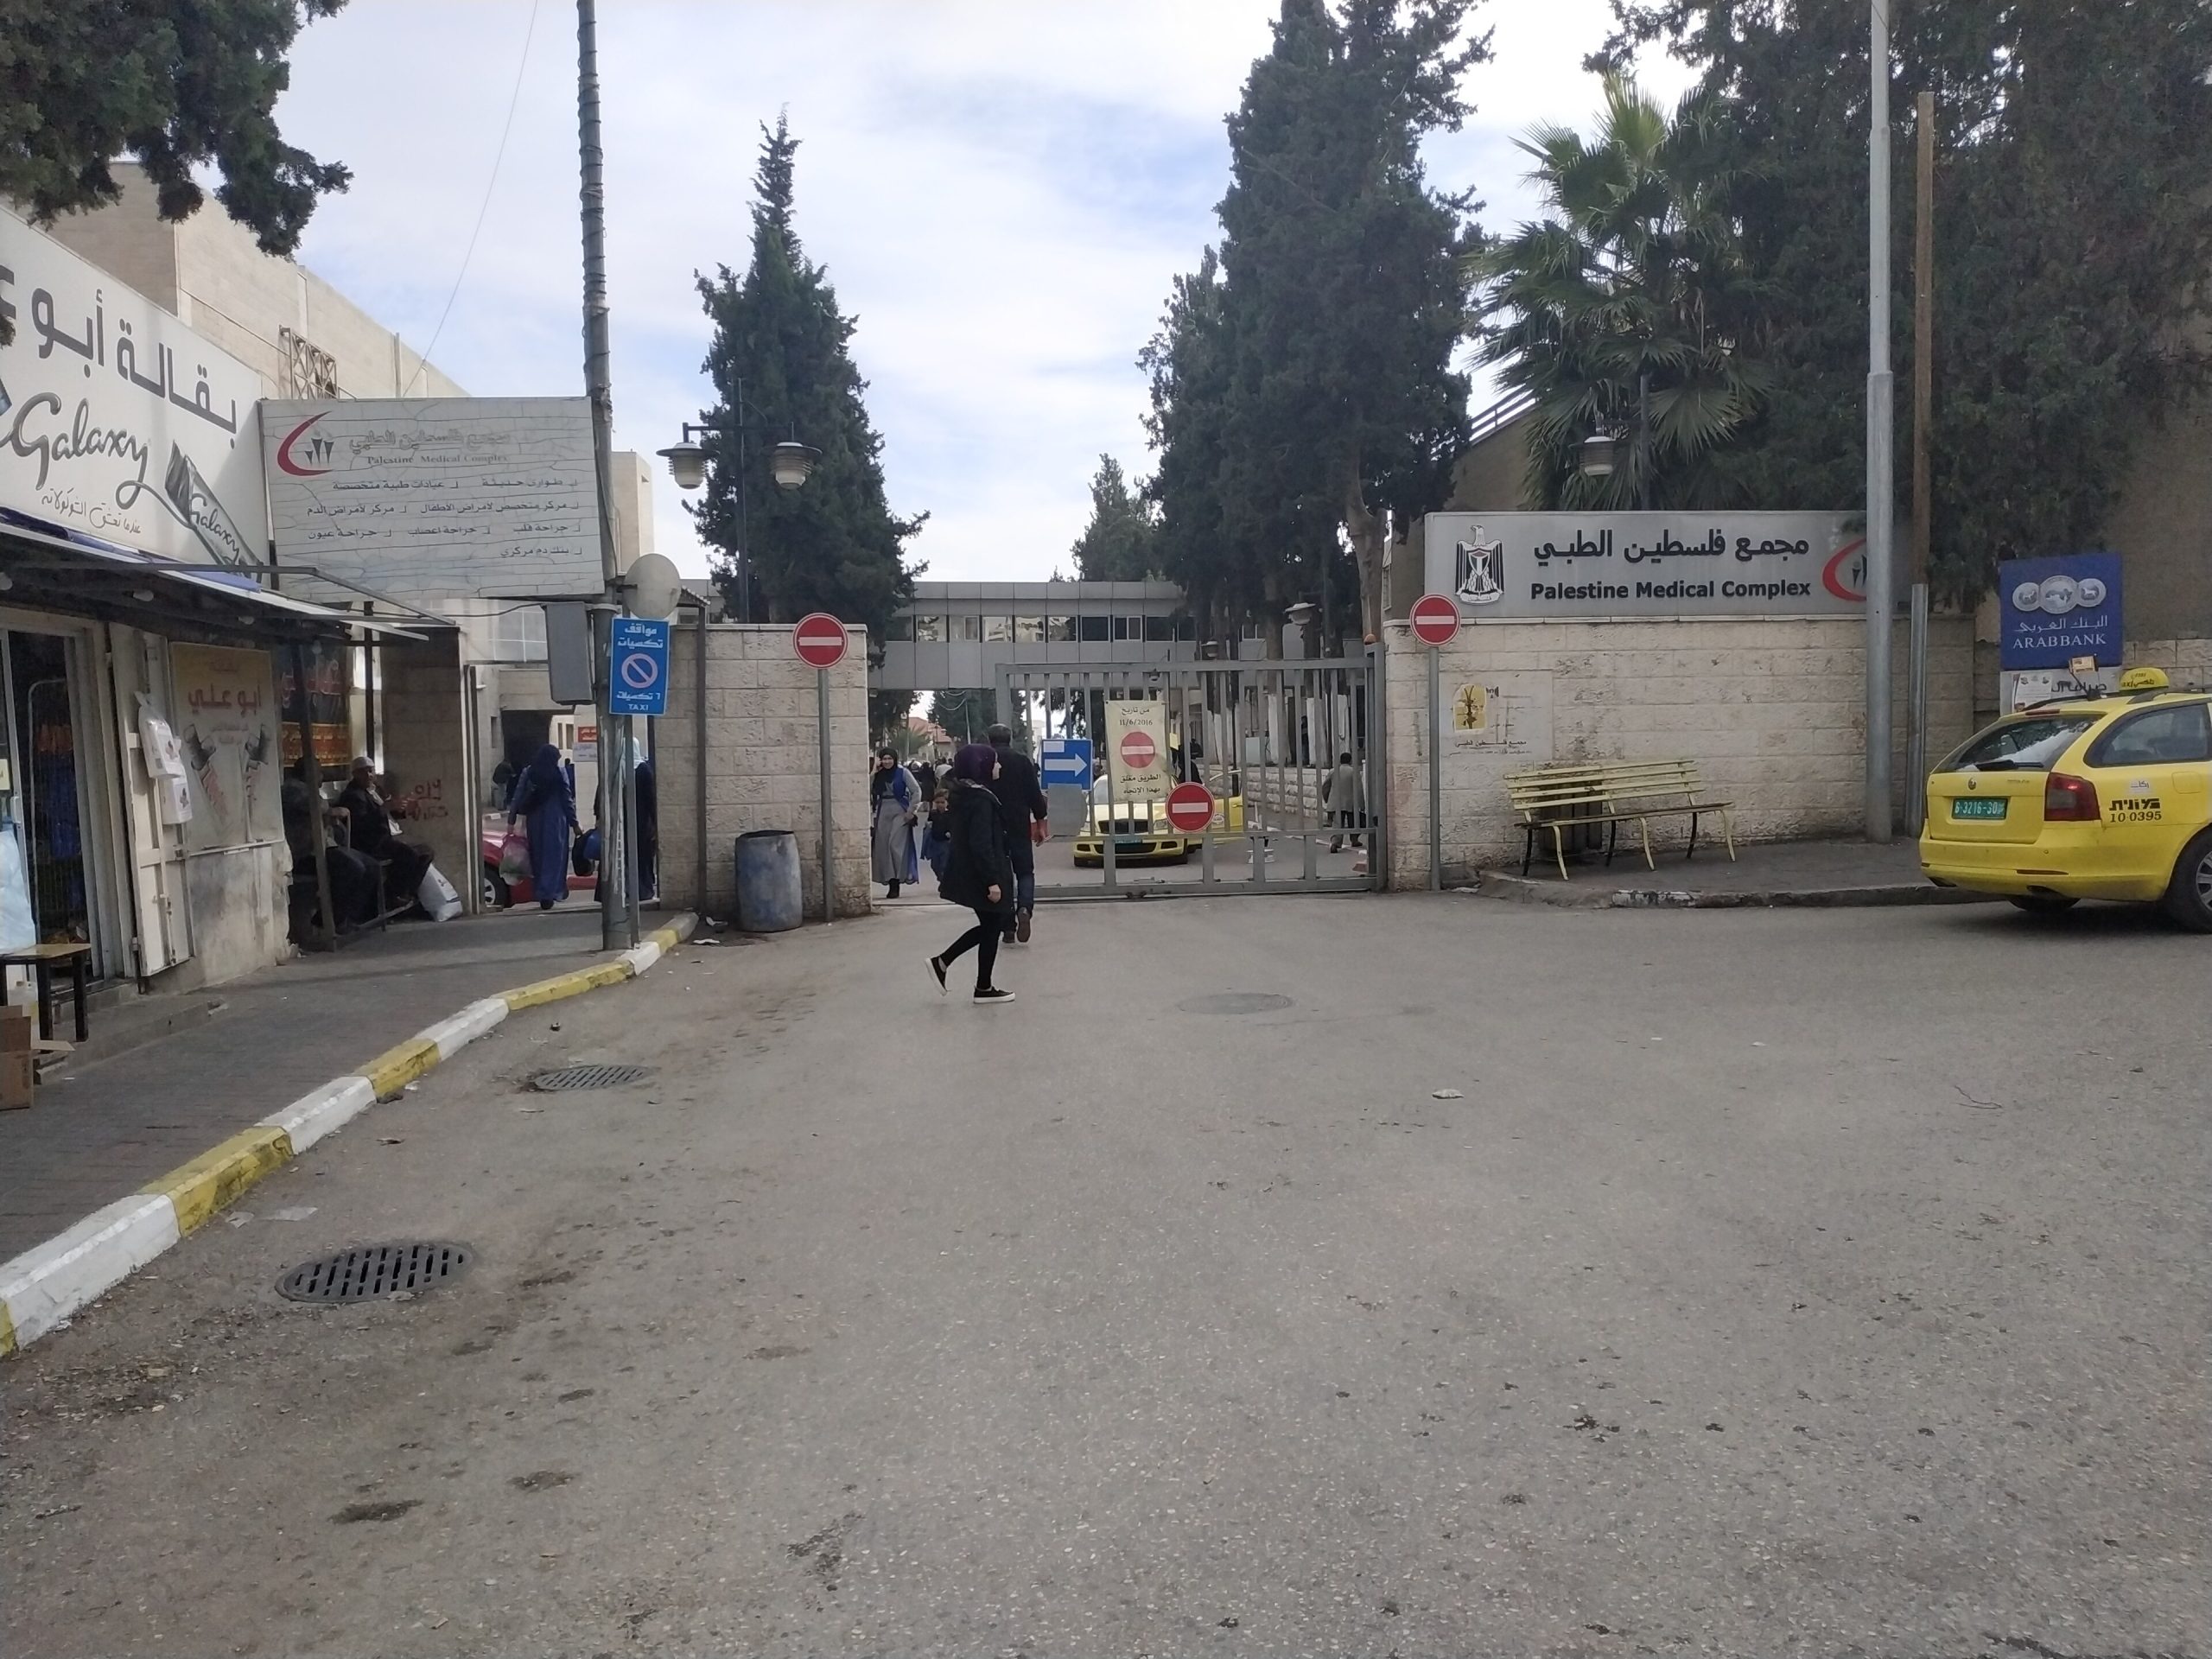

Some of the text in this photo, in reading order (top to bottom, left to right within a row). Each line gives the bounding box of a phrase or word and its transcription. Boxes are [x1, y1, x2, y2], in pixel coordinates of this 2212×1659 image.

[31, 288, 105, 378] أبو
[117, 318, 237, 449] بقالة
[4, 391, 149, 510] Galaxy
[190, 493, 240, 566] Galaxy
[1534, 529, 1809, 567] مجمع فلسطين الطبي
[1531, 579, 1811, 600] Palestine Medical Complex
[624, 622, 658, 638] مواقف
[2070, 614, 2108, 629] البنك
[617, 637, 664, 650] تكسيات
[1119, 718, 1154, 727] 11/6/2016
[1137, 773, 1161, 783] الطريق
[2108, 798, 2161, 811] מונית
